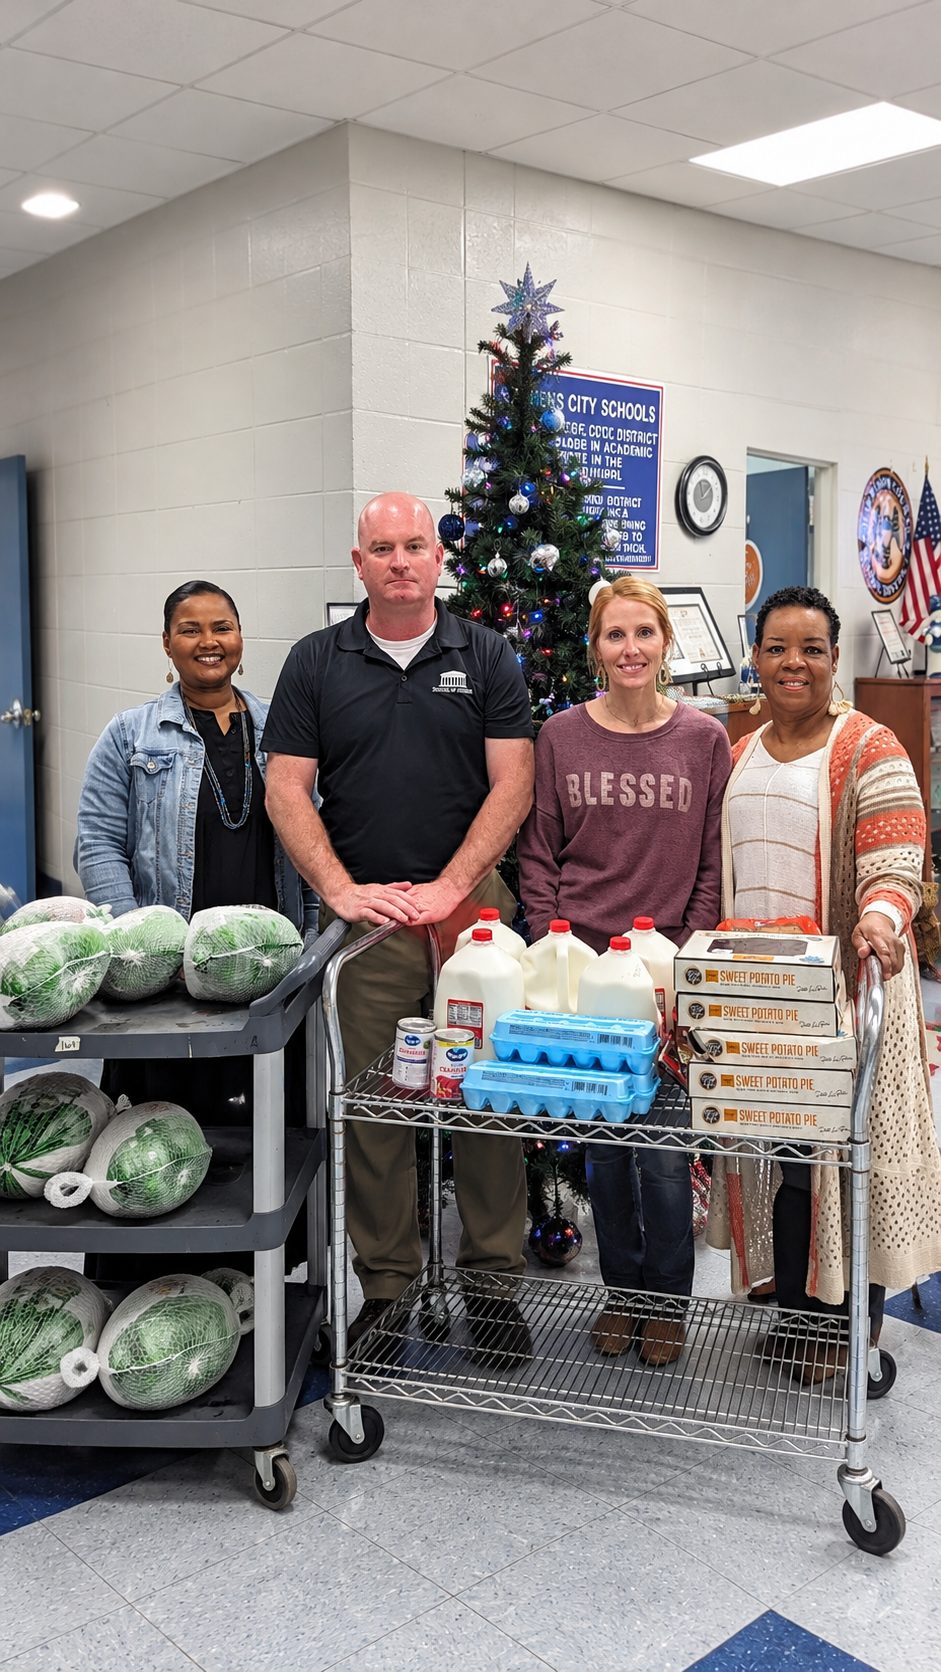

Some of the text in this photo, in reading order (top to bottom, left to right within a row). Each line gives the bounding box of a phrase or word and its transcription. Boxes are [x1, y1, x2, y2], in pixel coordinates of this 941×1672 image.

[568, 394, 597, 415] CITY
[601, 399, 656, 423] SCHOOLS
[591, 440, 600, 452] IN
[591, 454, 602, 465] IN
[605, 456, 623, 468] THE
[632, 531, 643, 542] TO
[565, 771, 693, 813] BLESSED
[720, 969, 748, 983] SWEET
[750, 972, 780, 985] POTATO
[783, 973, 796, 986] PIE
[723, 1005, 749, 1018] SWEET
[752, 1007, 784, 1020] POTATO
[786, 1008, 799, 1021] PIE
[741, 1041, 819, 1057] SWEET POTATO PIE
[736, 1075, 763, 1088] SWEET
[766, 1076, 798, 1089] POTATO
[801, 1078, 815, 1091] PIE
[739, 1109, 767, 1122] SWEET
[769, 1111, 801, 1125] POTATO
[804, 1114, 817, 1127] PIE
